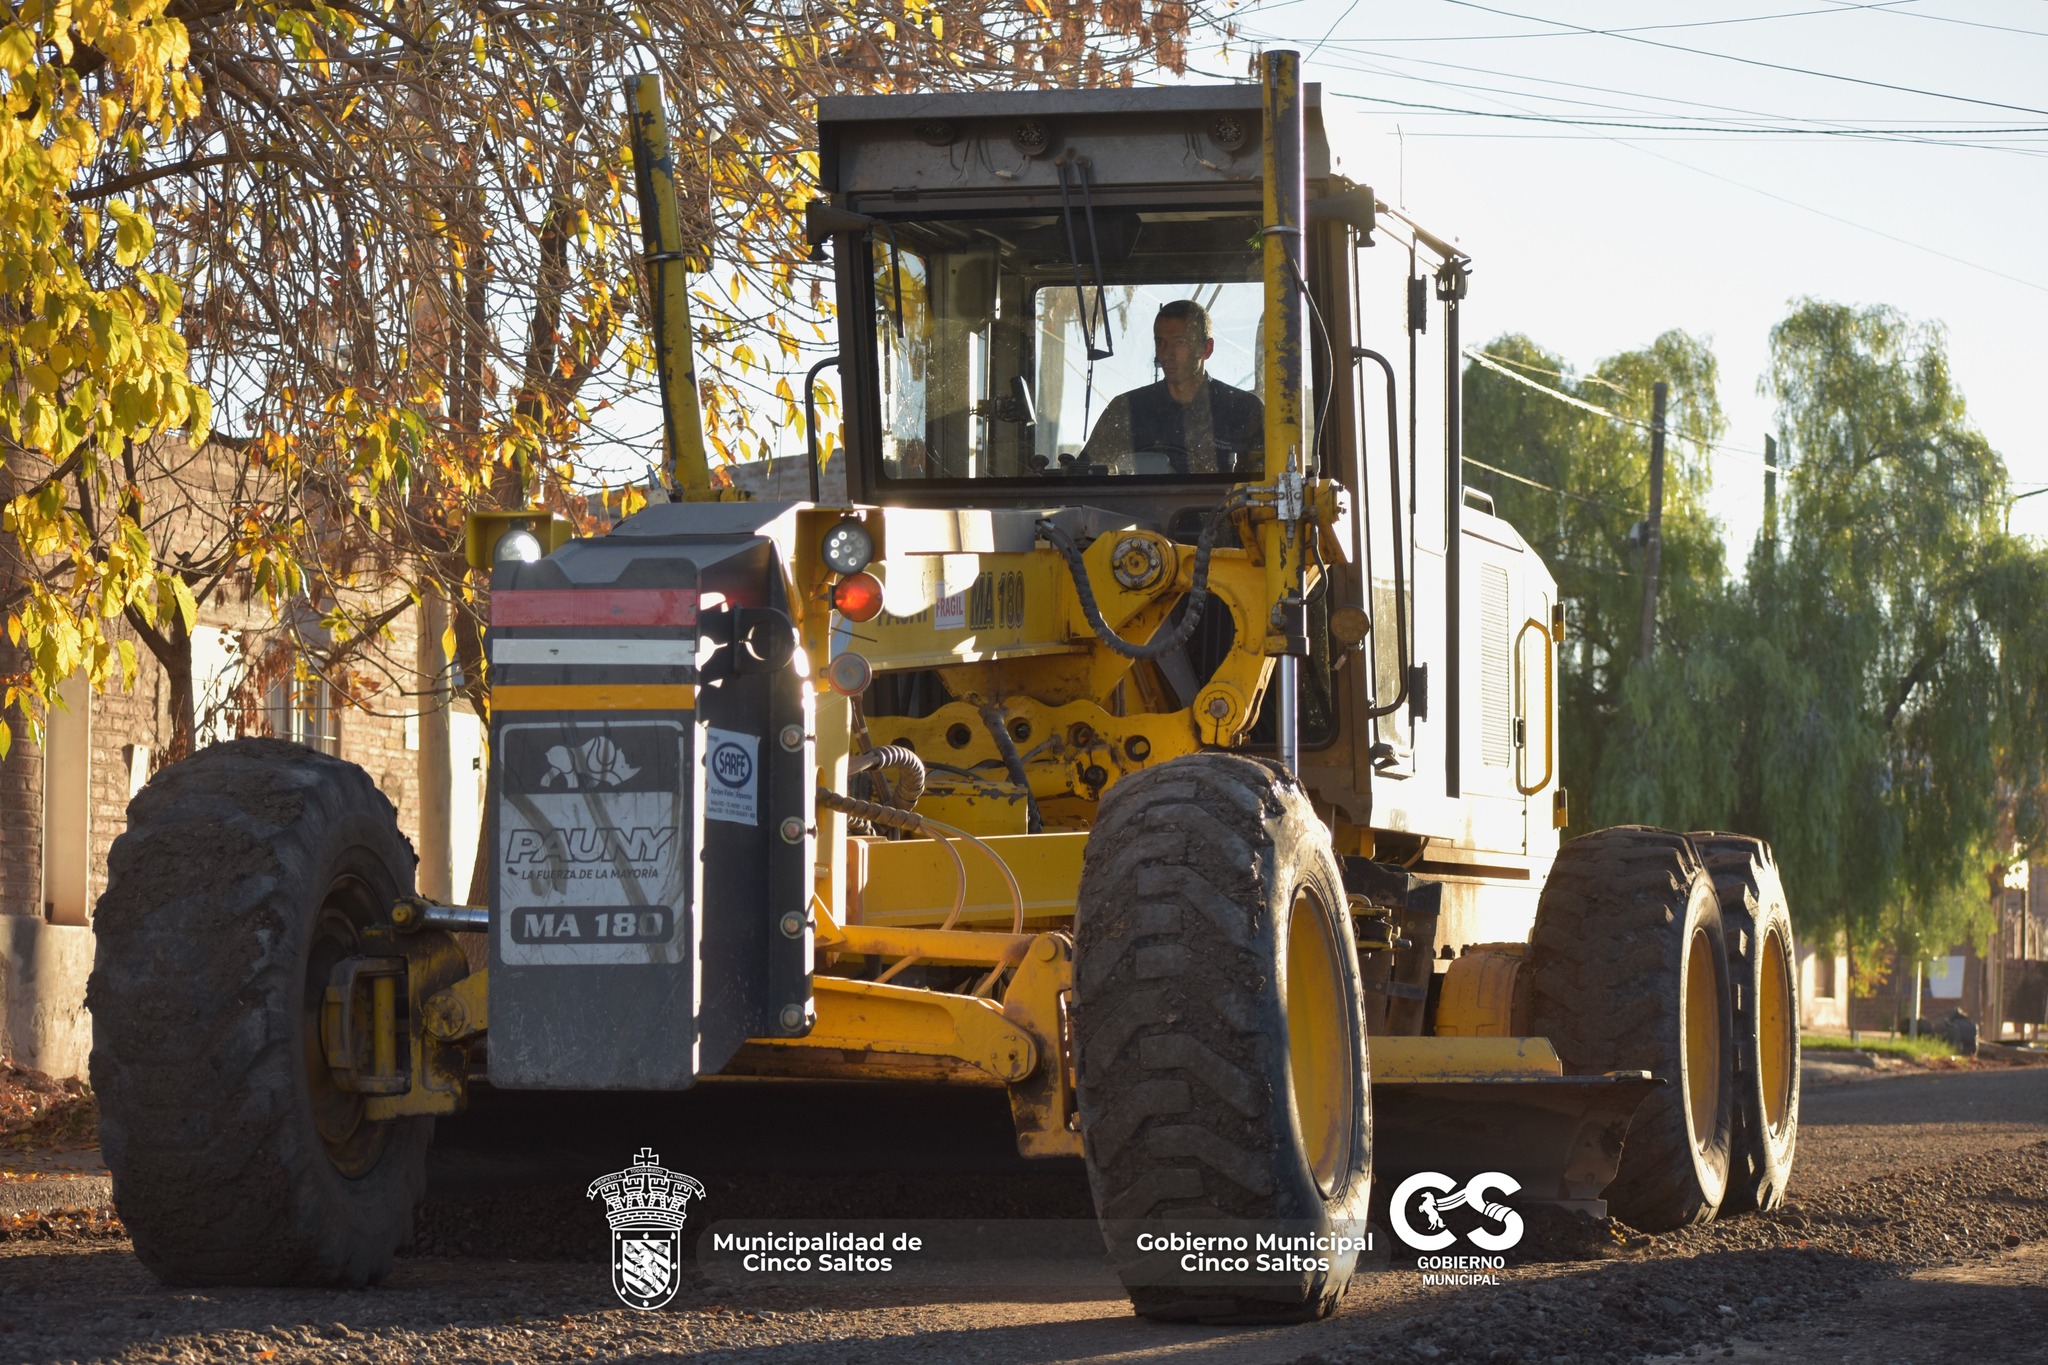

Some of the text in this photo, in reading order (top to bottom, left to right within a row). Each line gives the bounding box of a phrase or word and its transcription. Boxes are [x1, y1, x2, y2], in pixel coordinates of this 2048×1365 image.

[935, 596, 964, 618] FRAGIL
[970, 571, 1025, 630] MA 180
[719, 750, 746, 777] SARFE
[505, 827, 679, 864] PAUNY
[521, 866, 659, 880] LA FUERZA DE LA MAYORÍA
[523, 912, 664, 938] MA 180
